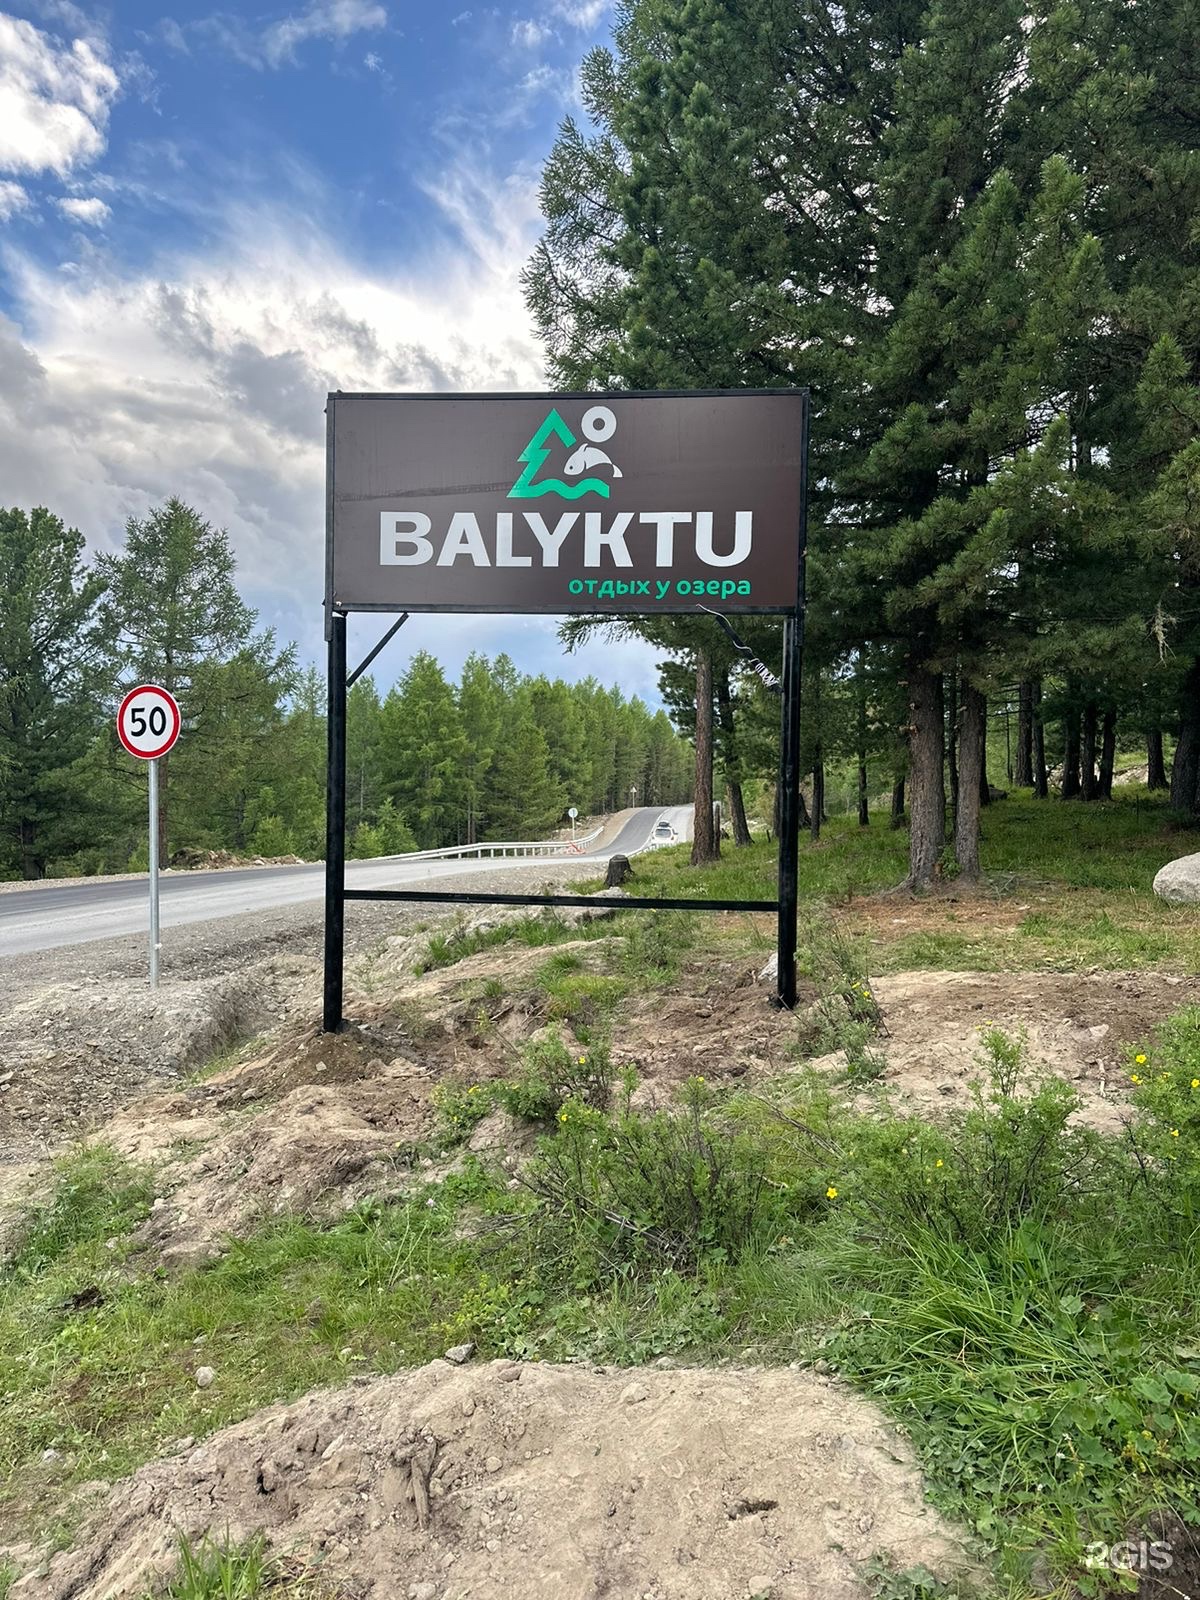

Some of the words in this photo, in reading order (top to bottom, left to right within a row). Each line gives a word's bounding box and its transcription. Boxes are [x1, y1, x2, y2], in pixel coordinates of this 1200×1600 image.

[379, 511, 753, 568] BALYKTU
[568, 579, 650, 598] отдых
[656, 580, 671, 599] у
[677, 579, 751, 599] озера
[131, 706, 167, 737] 50
